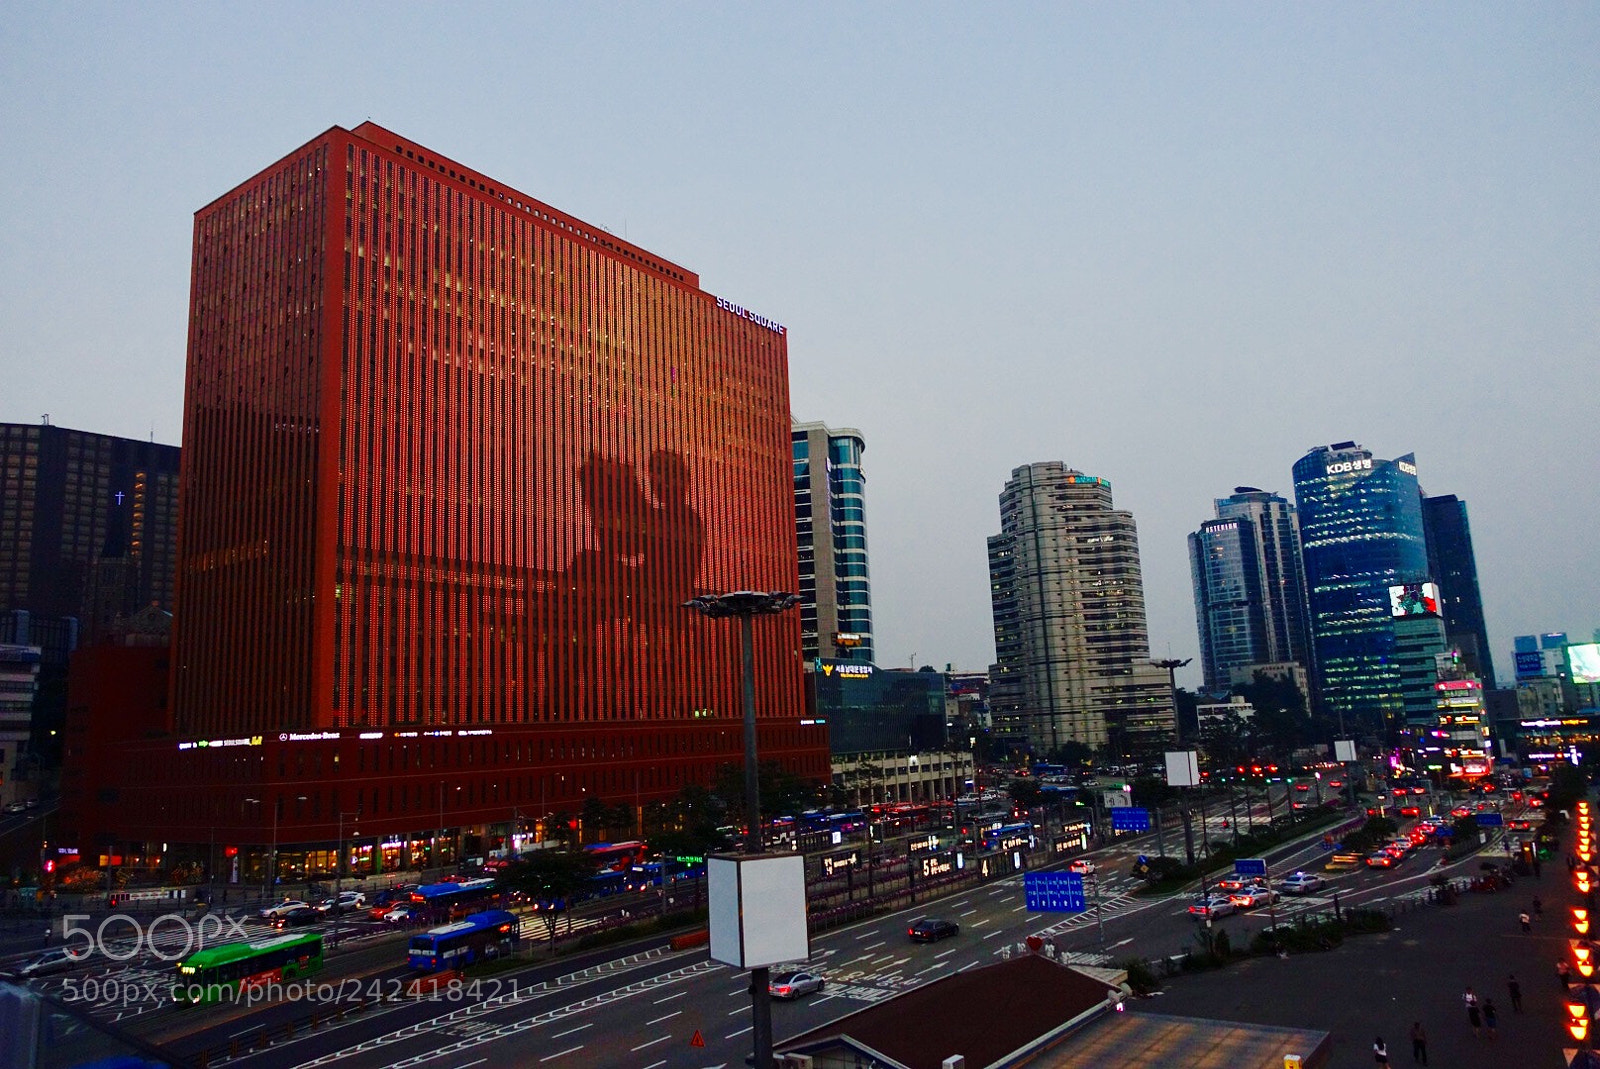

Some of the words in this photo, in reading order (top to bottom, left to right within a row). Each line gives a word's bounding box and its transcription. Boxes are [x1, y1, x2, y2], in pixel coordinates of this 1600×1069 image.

[716, 296, 748, 319] SEOUL
[748, 310, 784, 335] SQUARE
[1326, 459, 1372, 475] KDB생명
[289, 732, 340, 742] Mercedes-Benz
